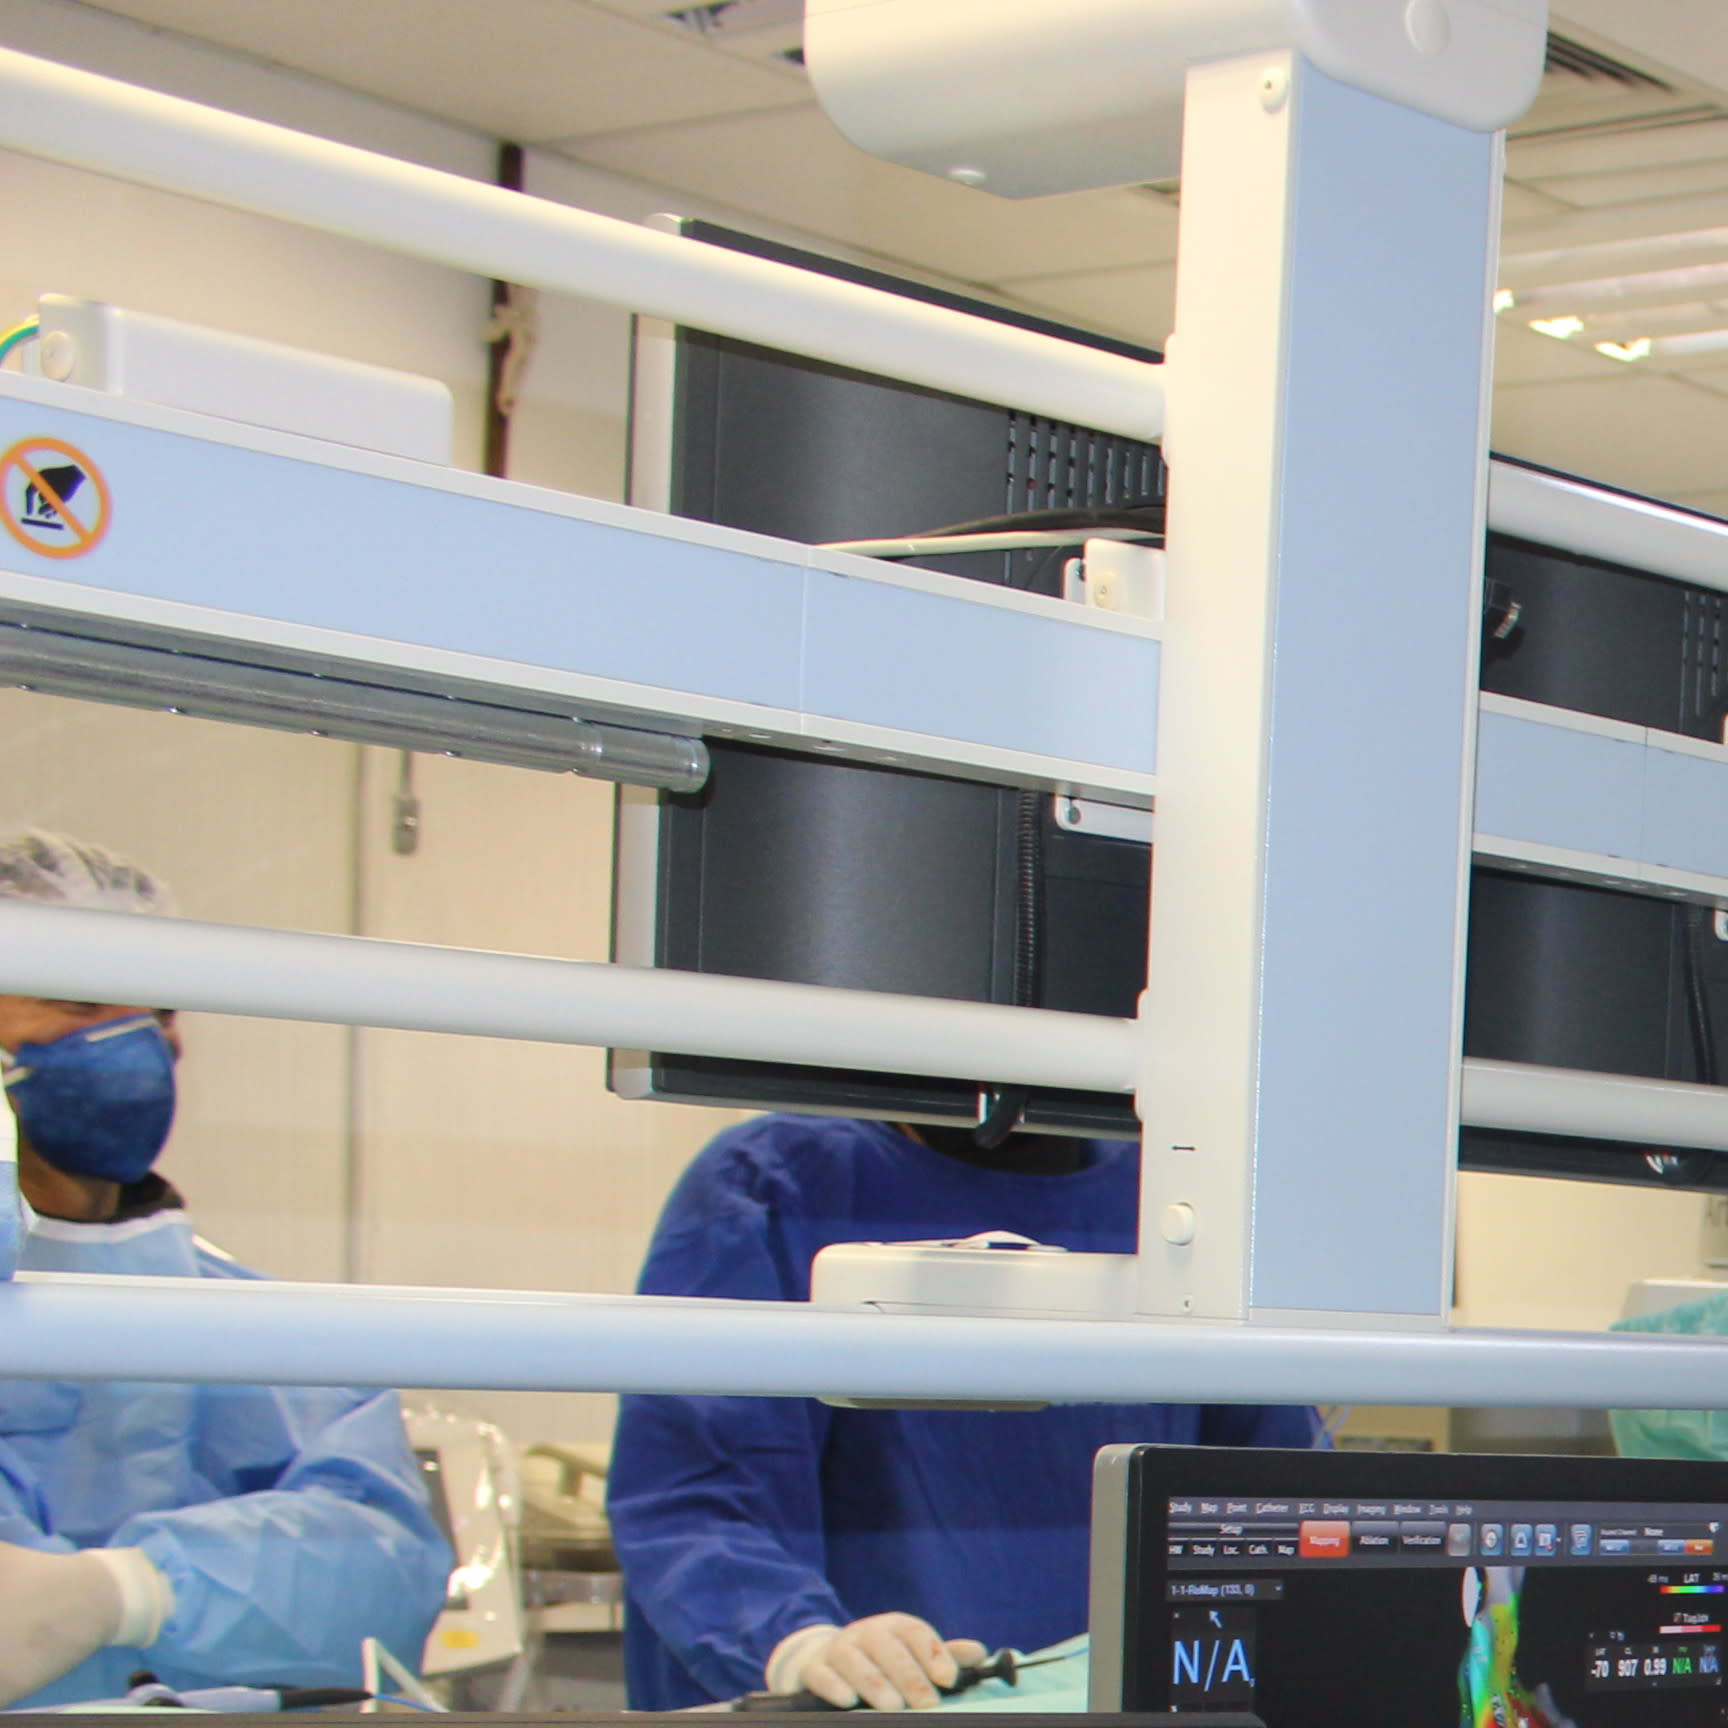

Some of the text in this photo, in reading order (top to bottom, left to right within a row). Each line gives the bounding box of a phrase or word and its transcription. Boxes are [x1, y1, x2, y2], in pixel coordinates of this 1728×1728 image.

[1168, 1502, 1192, 1514] Study
[1256, 1503, 1289, 1514] Catheter
[1220, 1523, 1243, 1536] Setup
[1402, 1534, 1442, 1546] Verification
[1193, 1544, 1215, 1557] Study
[1172, 1638, 1250, 1691] N/A
